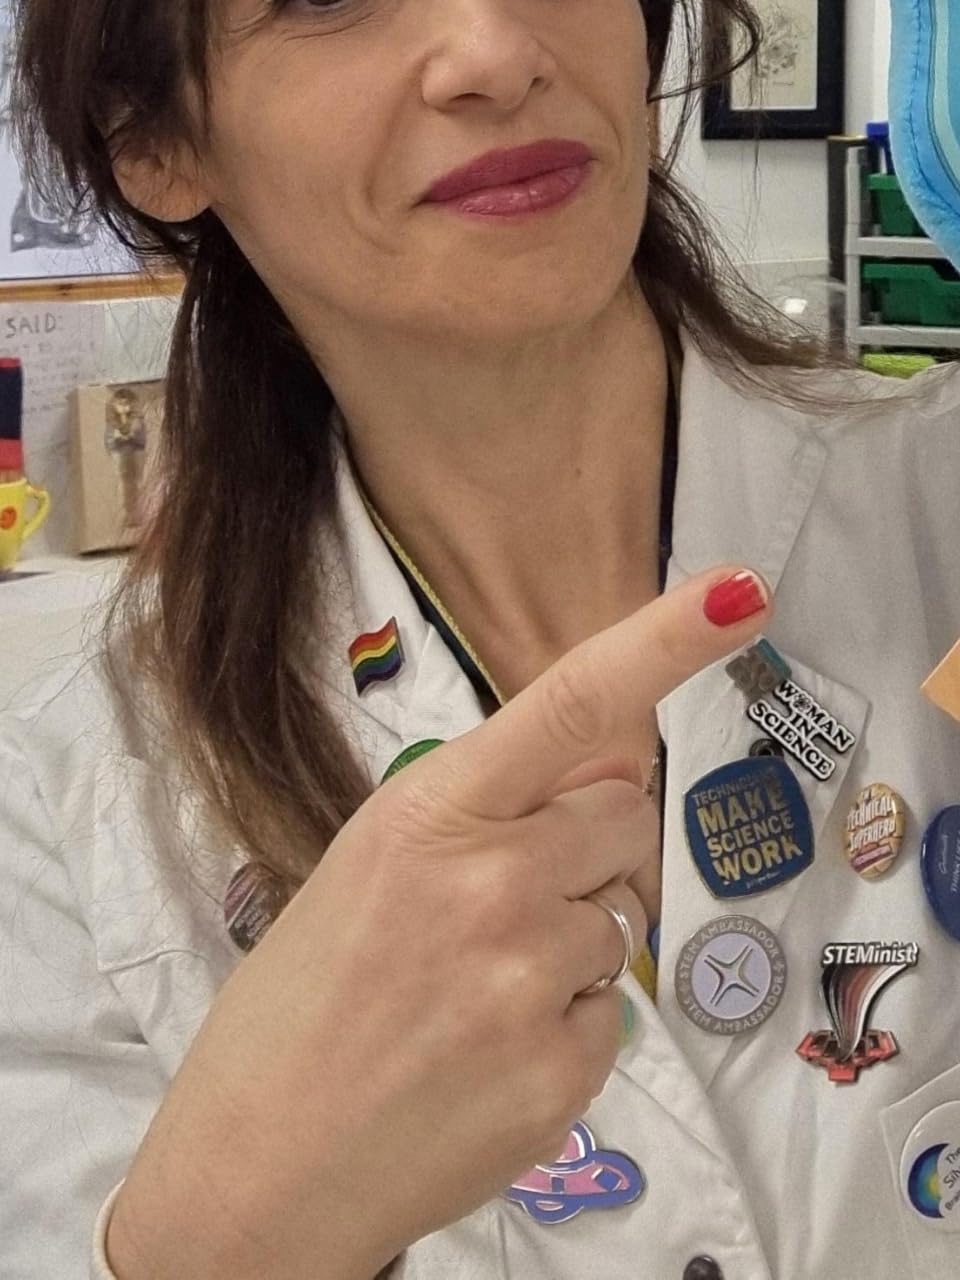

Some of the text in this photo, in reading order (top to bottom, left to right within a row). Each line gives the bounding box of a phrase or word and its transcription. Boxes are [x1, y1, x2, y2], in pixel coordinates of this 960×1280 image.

[752, 701, 833, 775] SCIENCE
[791, 713, 816, 738] IN
[696, 780, 788, 837] MAKE
[706, 810, 795, 858] SCIENCE
[711, 834, 803, 885] WORK
